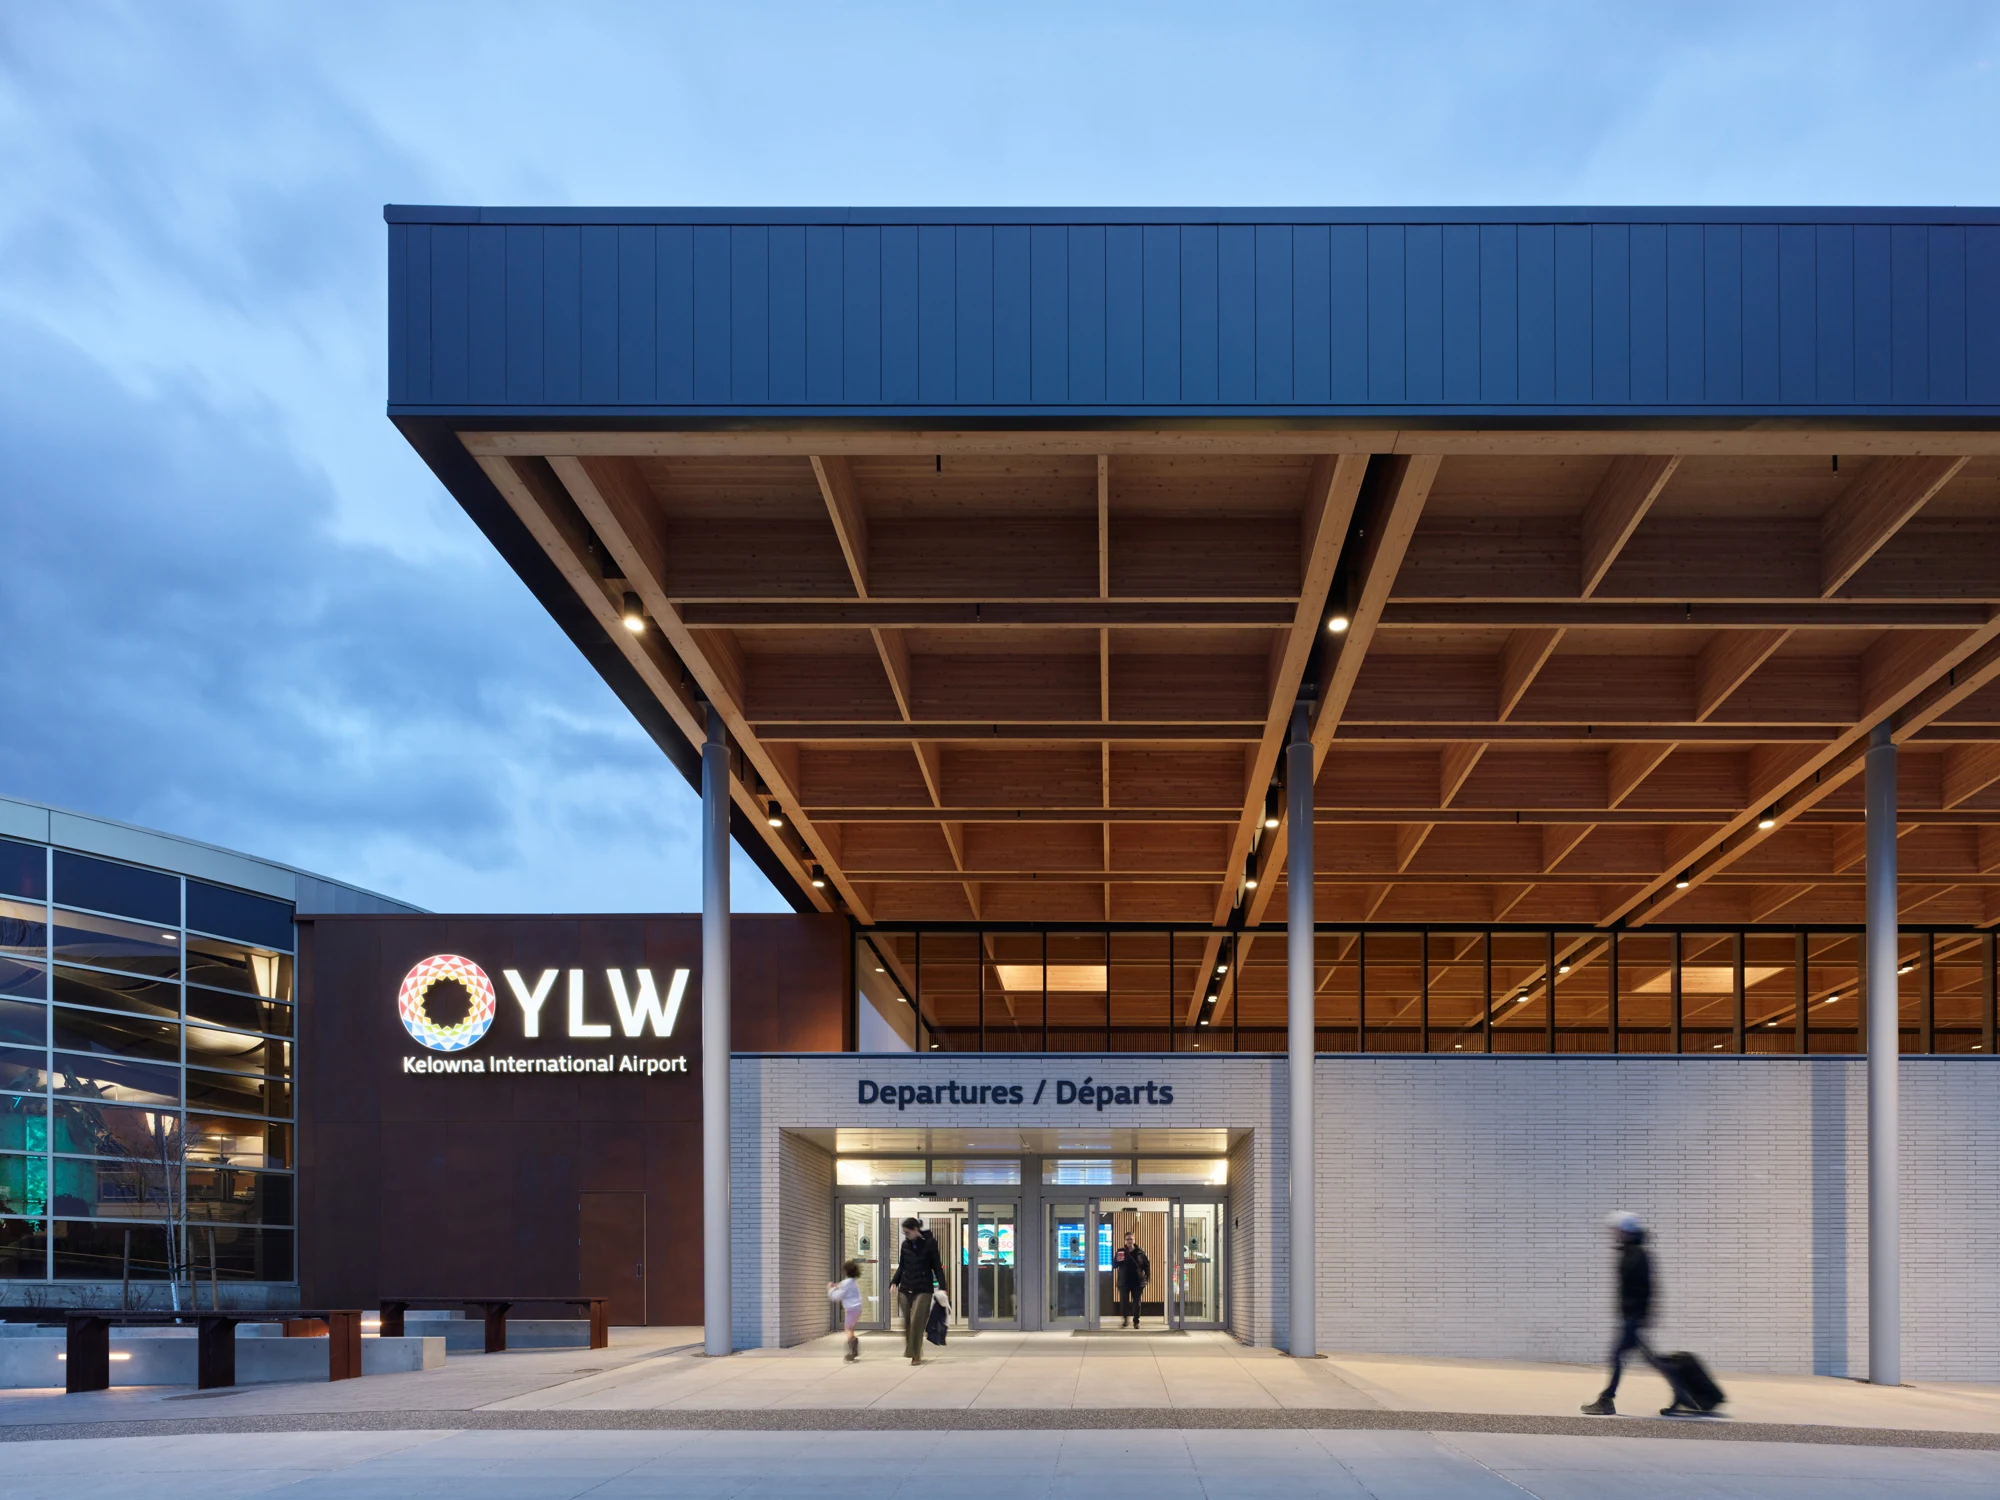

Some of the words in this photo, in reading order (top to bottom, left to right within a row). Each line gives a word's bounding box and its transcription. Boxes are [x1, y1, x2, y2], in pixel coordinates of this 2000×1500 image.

[503, 968, 690, 1038] YLW
[403, 1056, 485, 1073] Kelowna
[490, 1054, 614, 1073] International
[619, 1055, 687, 1076] Airport
[858, 1080, 1024, 1111] Departures
[1056, 1076, 1174, 1111] Départs
